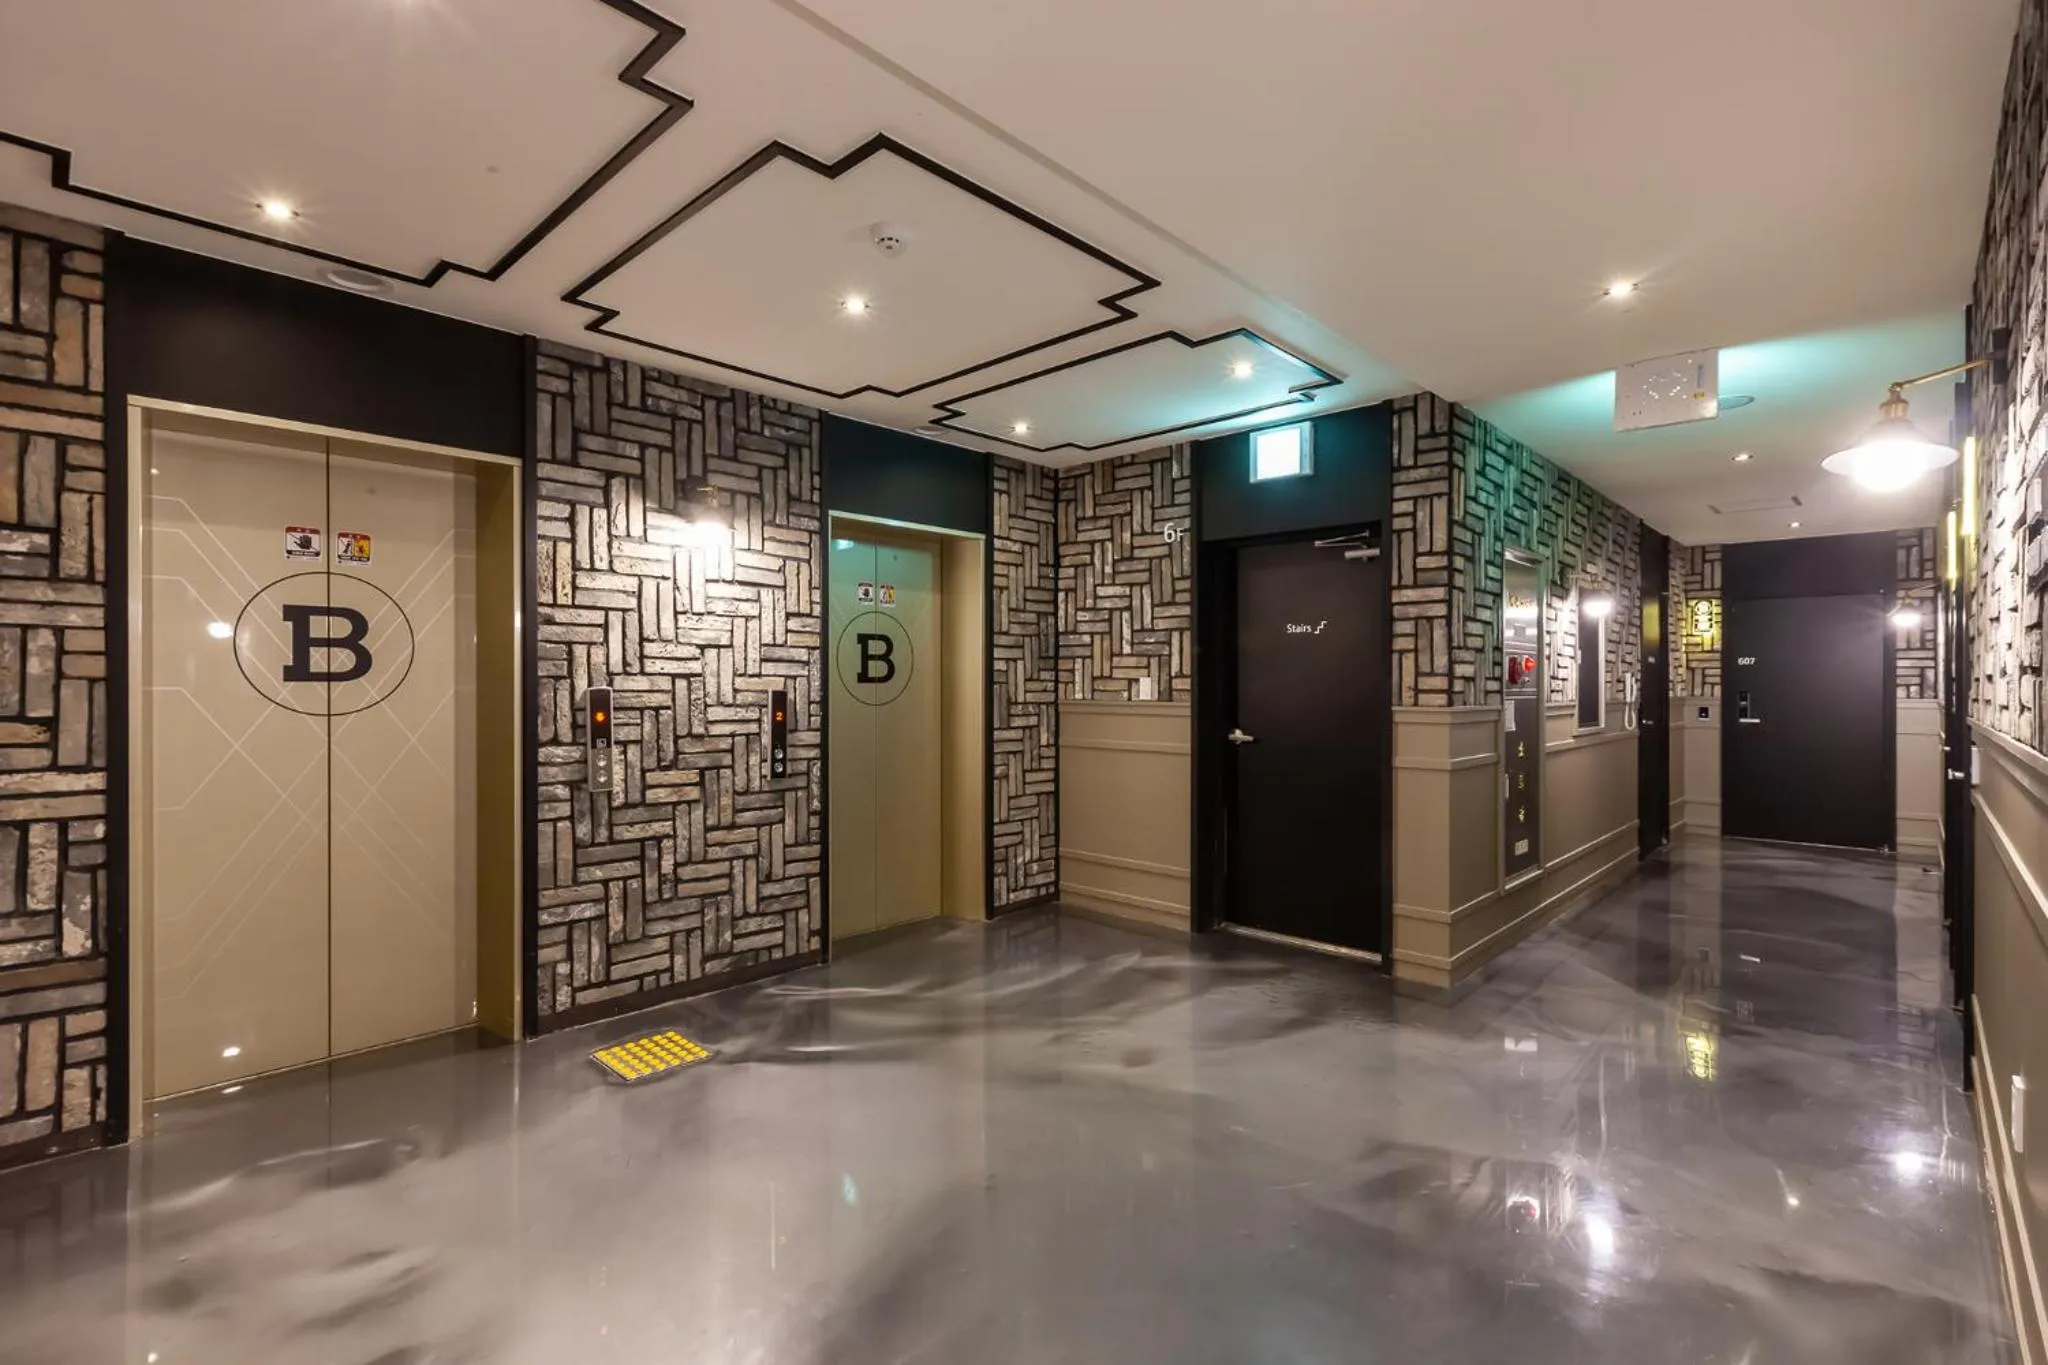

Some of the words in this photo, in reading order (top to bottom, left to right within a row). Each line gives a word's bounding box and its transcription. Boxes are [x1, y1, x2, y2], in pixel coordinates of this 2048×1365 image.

[1163, 522, 1185, 543] 6F
[1286, 623, 1312, 634] Stairs
[283, 604, 373, 682] B
[857, 633, 895, 683] B
[1737, 656, 1757, 667] 607
